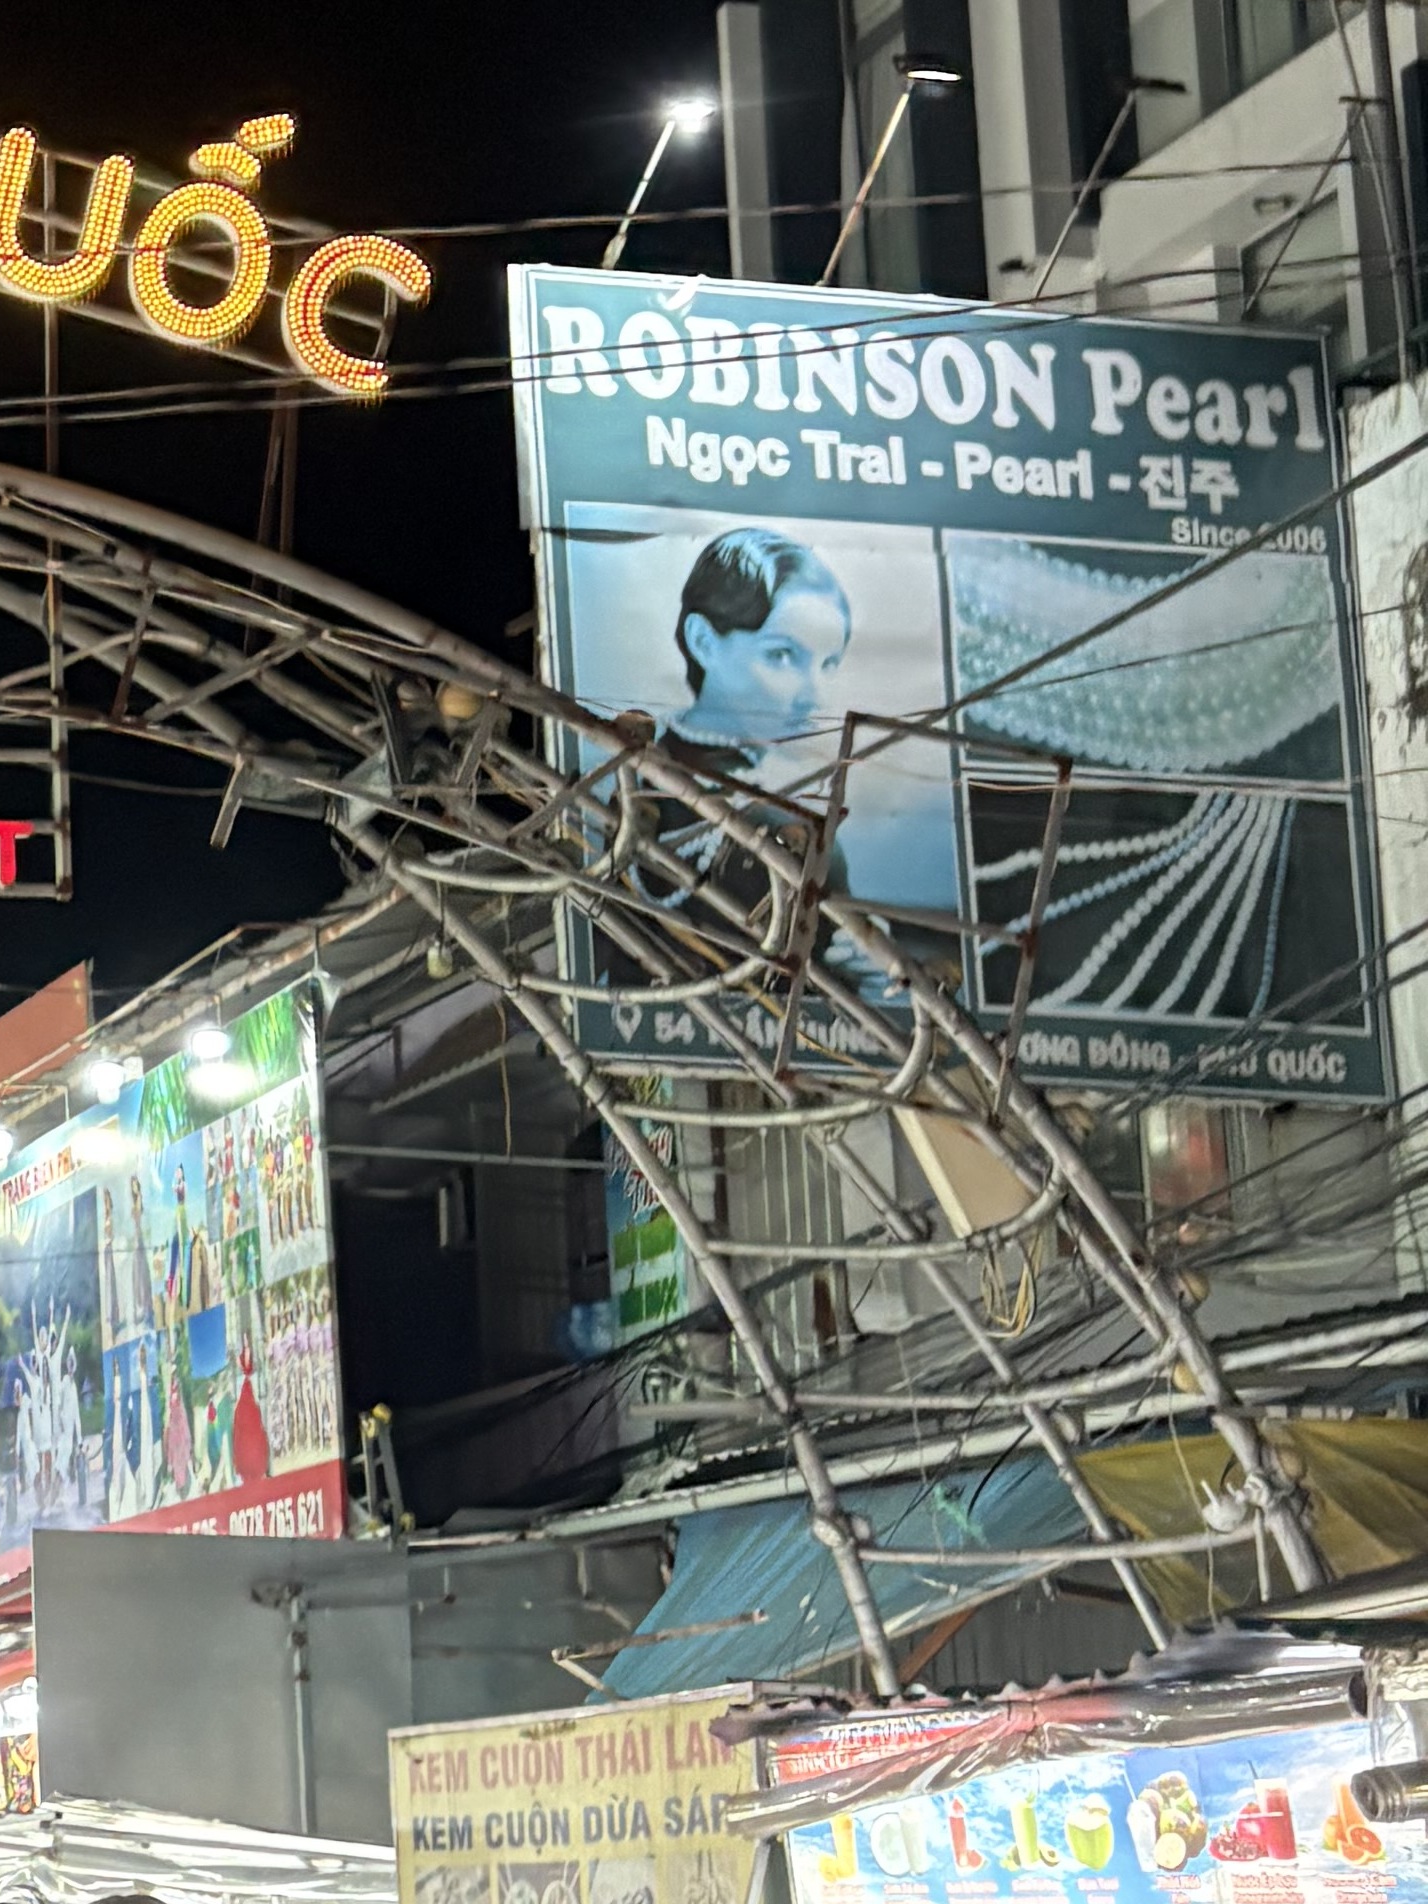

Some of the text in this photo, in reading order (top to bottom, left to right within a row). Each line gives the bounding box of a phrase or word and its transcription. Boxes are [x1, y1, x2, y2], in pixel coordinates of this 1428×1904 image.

[543, 304, 1327, 452] ROBINSON Pearl
[646, 414, 791, 486] Ngọc
[955, 441, 1095, 500] Pearl
[1139, 451, 1241, 514] 진주
[1266, 1040, 1347, 1084] QUỐC
[297, 1488, 325, 1537] 621
[408, 1747, 470, 1795] KEM
[480, 1734, 566, 1797] CUỘN
[574, 1718, 652, 1781] THÁI
[412, 1814, 473, 1852] KEM
[485, 1802, 571, 1856] CUỘN
[582, 1793, 653, 1845] DỪA
